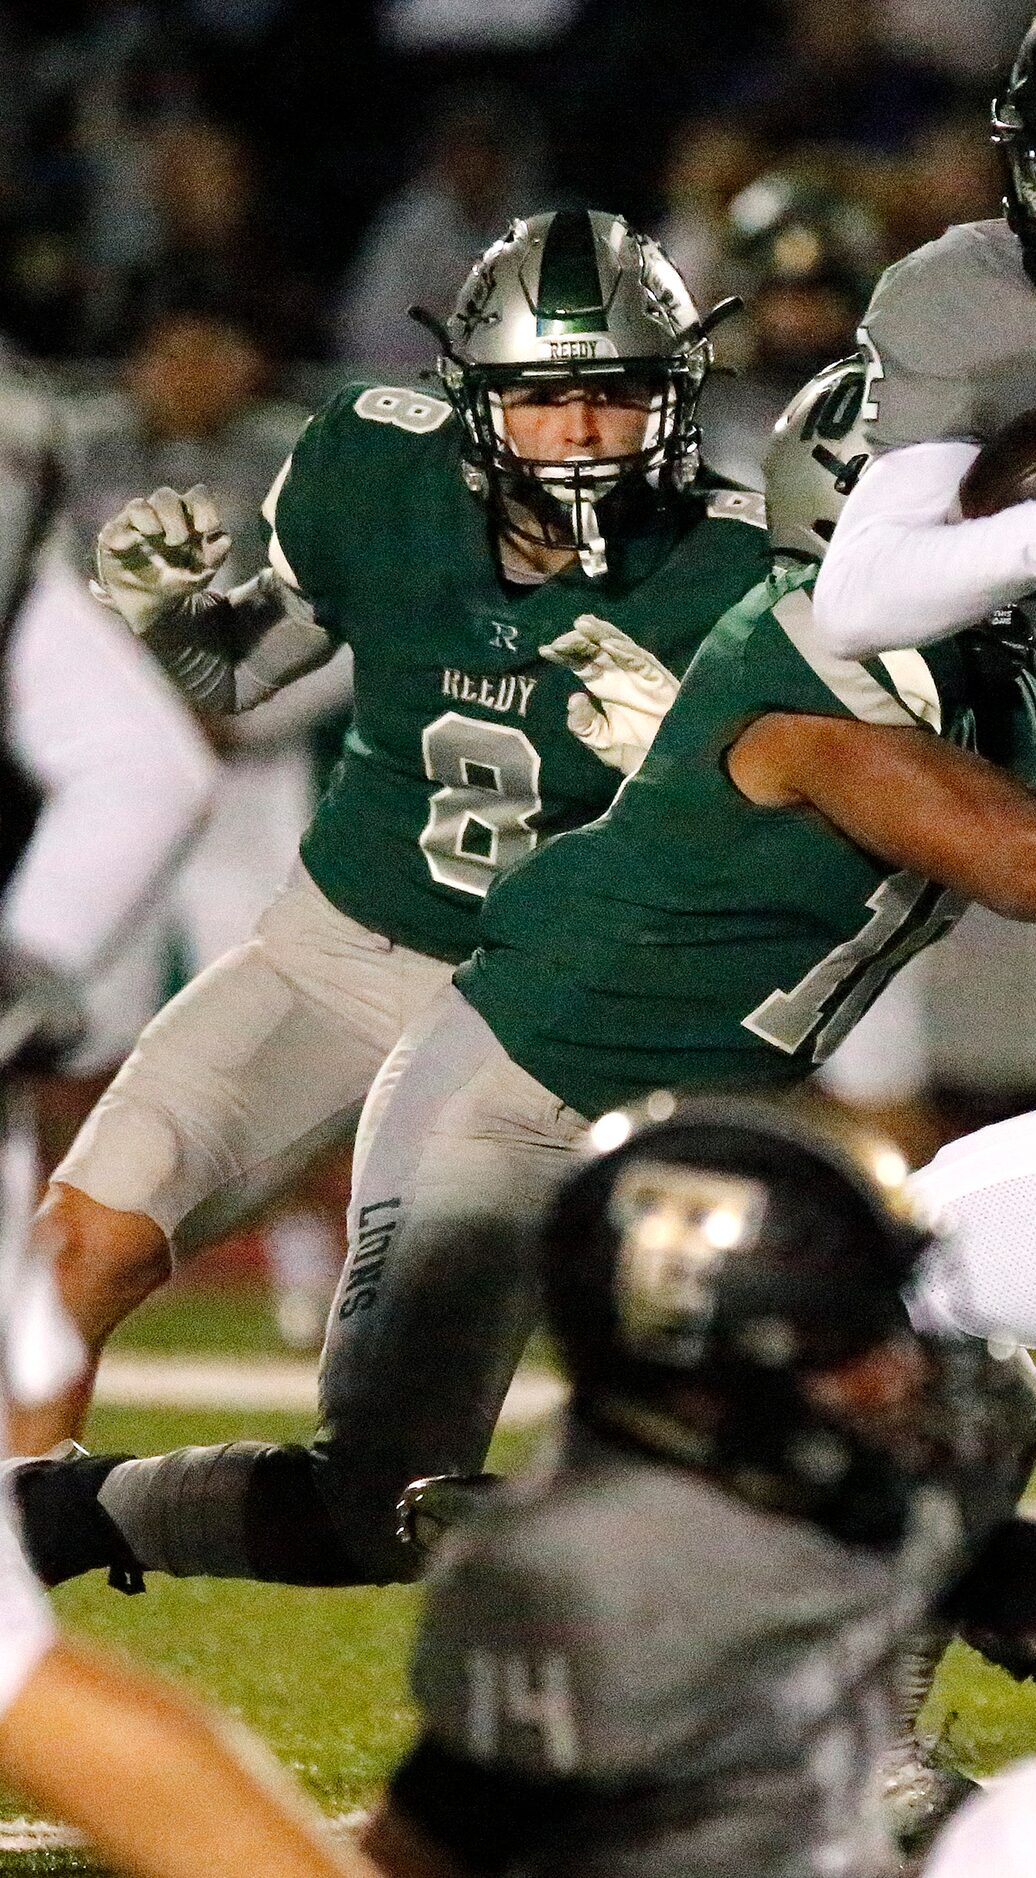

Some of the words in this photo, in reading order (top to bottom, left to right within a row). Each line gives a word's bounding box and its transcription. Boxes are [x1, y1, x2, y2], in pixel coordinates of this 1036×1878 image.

[550, 340, 597, 359] REEDY
[353, 385, 454, 434] 8
[489, 620, 519, 652] R
[442, 666, 538, 718] REEDY
[419, 710, 542, 898] 8
[338, 1196, 402, 1322] LIONS
[466, 1648, 582, 1775] 14
